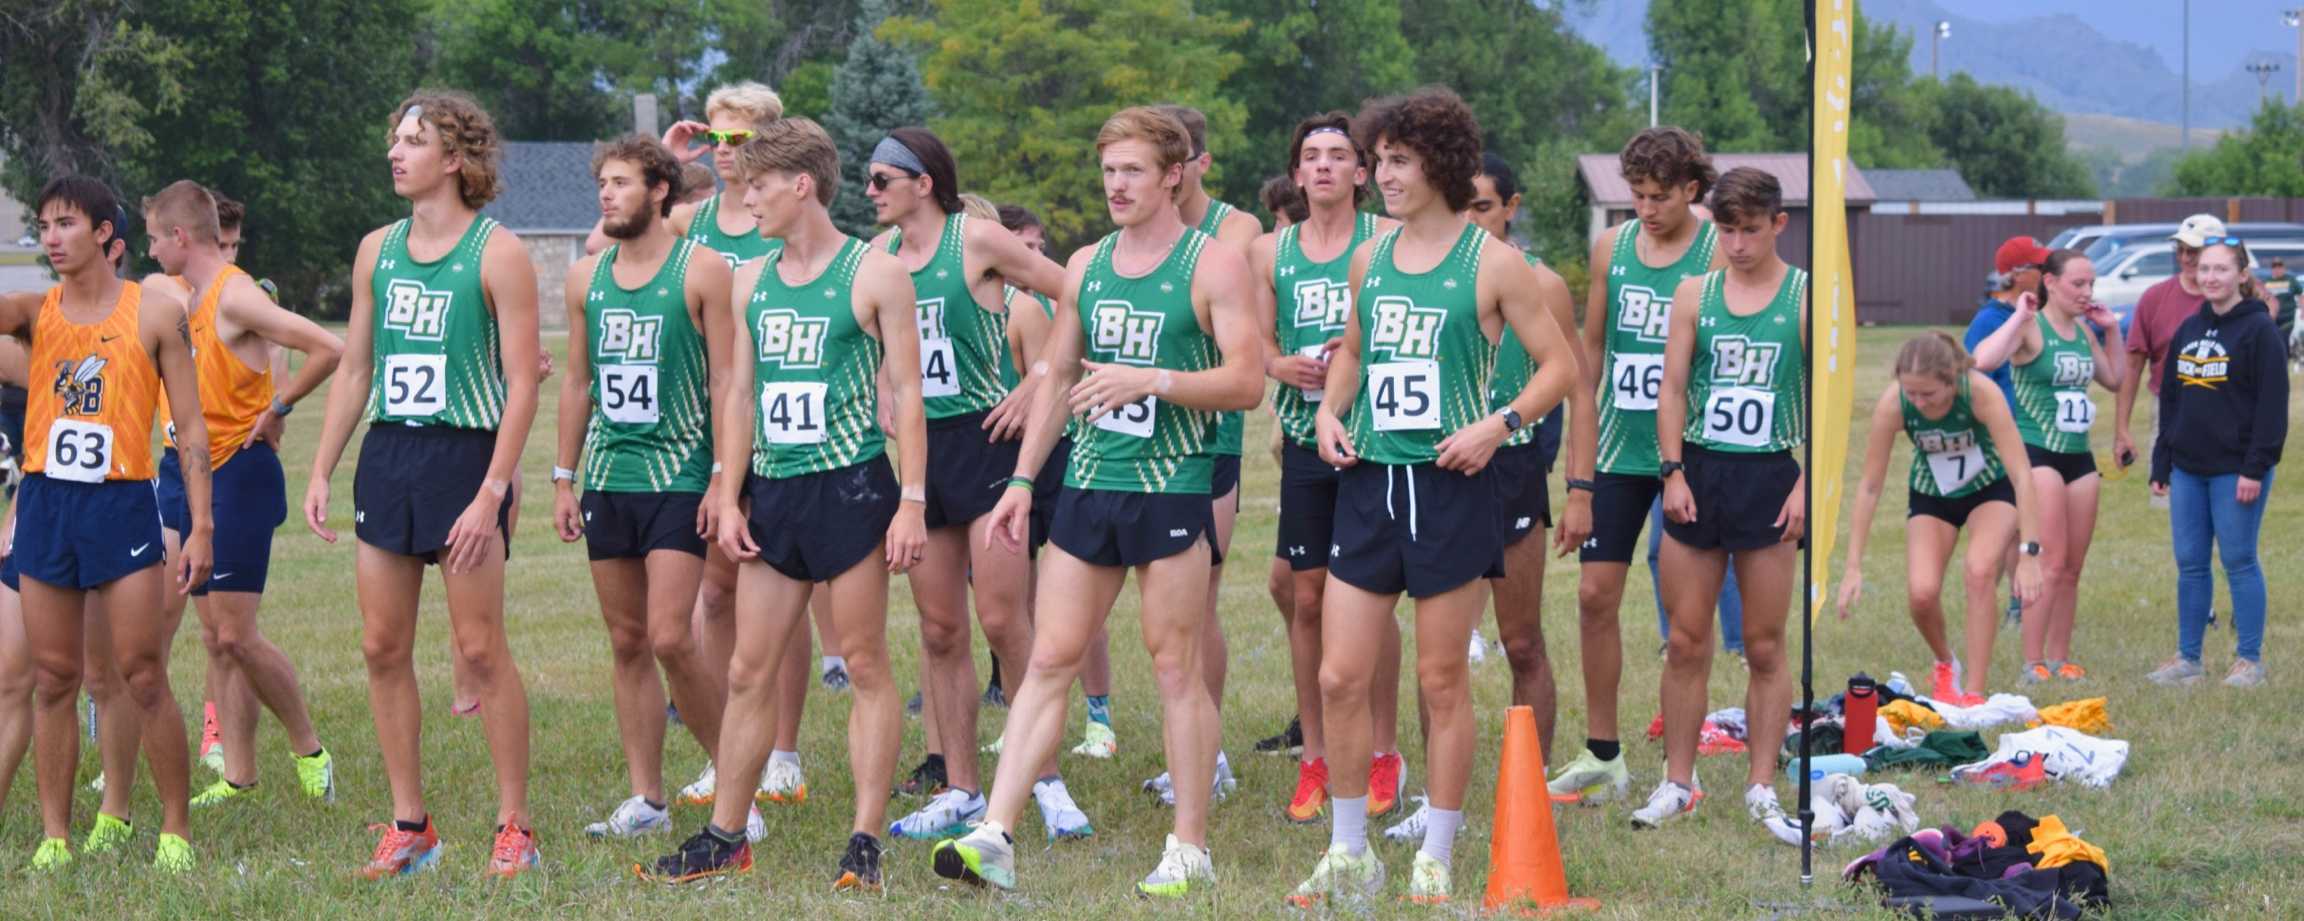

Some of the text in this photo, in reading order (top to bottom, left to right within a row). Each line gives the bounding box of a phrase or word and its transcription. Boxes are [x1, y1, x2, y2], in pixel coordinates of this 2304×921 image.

[384, 279, 453, 342] BH
[915, 296, 946, 339] H
[1294, 278, 1352, 331] BH
[1617, 284, 1673, 343] BH
[598, 308, 663, 364] BH
[757, 308, 830, 369] BH
[1090, 299, 1165, 365] BH
[1370, 295, 1448, 361] BH
[921, 349, 951, 385] 4
[1618, 364, 1663, 399] 46
[1710, 334, 1781, 390] BH
[2053, 352, 2094, 388] BH
[389, 365, 437, 404] 52
[606, 374, 652, 410] 54
[1375, 374, 1430, 417] 45
[769, 392, 818, 431] 41
[1711, 397, 1764, 435] 50
[2062, 398, 2090, 424] 11
[55, 429, 105, 469] 63
[1914, 428, 1975, 454] BH
[1947, 455, 1966, 481] 7
